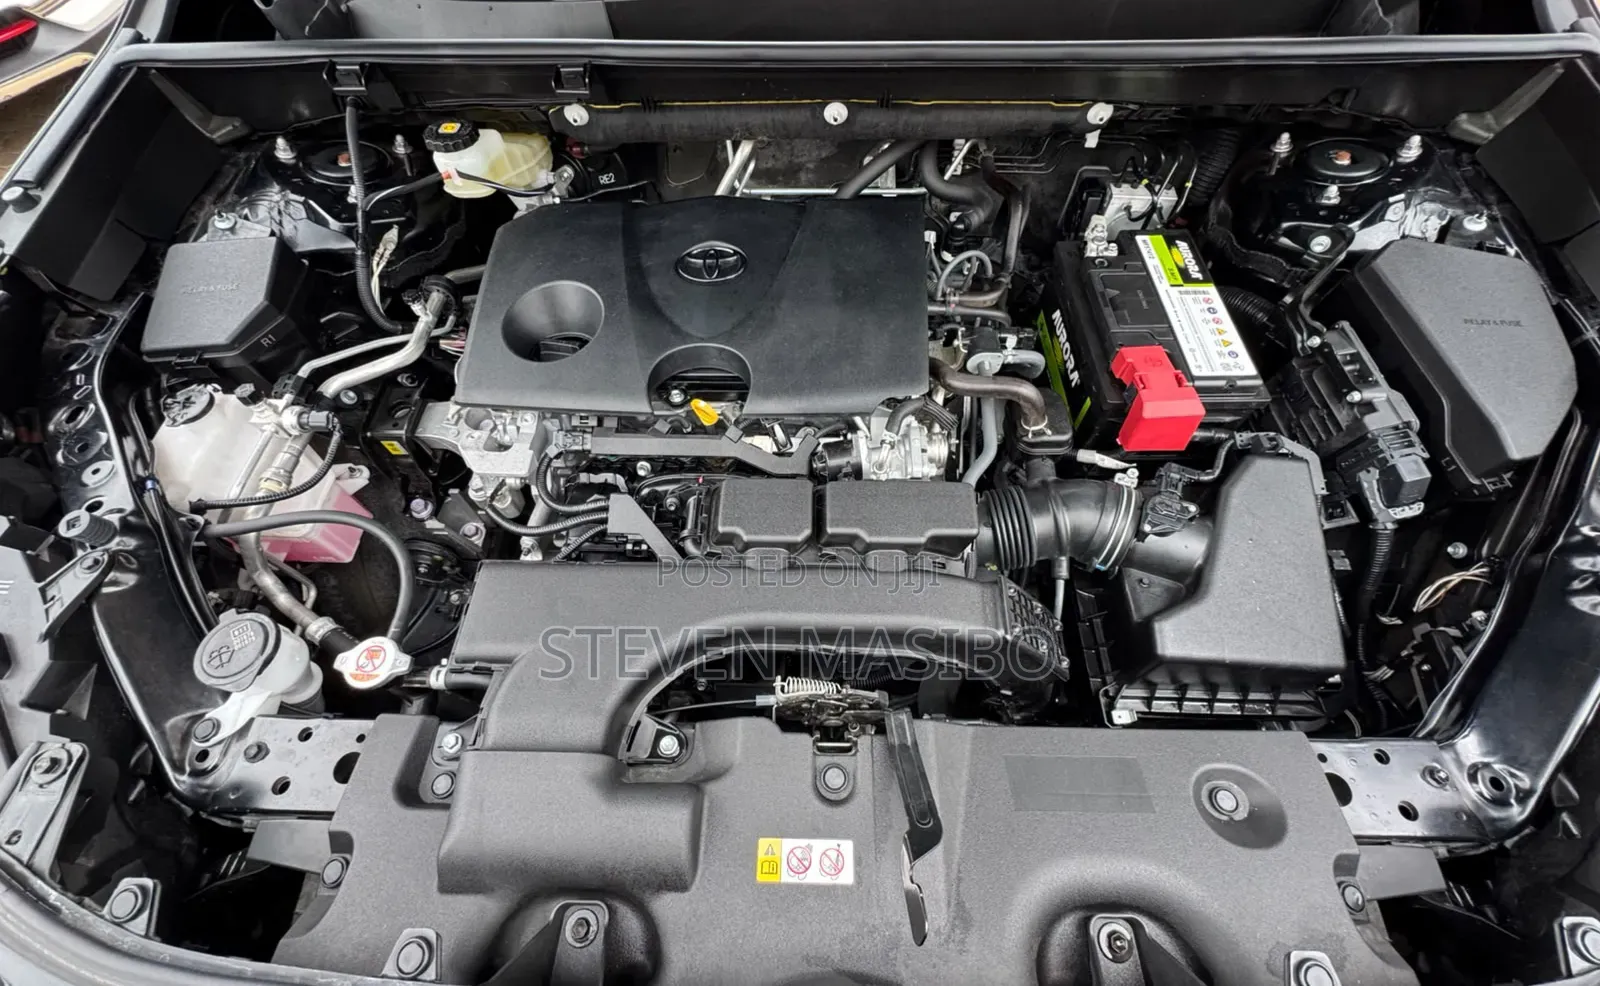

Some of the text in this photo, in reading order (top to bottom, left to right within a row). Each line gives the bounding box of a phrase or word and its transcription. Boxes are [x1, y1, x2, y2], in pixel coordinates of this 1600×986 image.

[598, 172, 616, 185] RE2
[1175, 239, 1203, 280] AURORA
[1463, 318, 1491, 326] RELAY
[1499, 319, 1523, 328] FUSE
[260, 334, 277, 348] R1
[1052, 308, 1080, 388] AURORA
